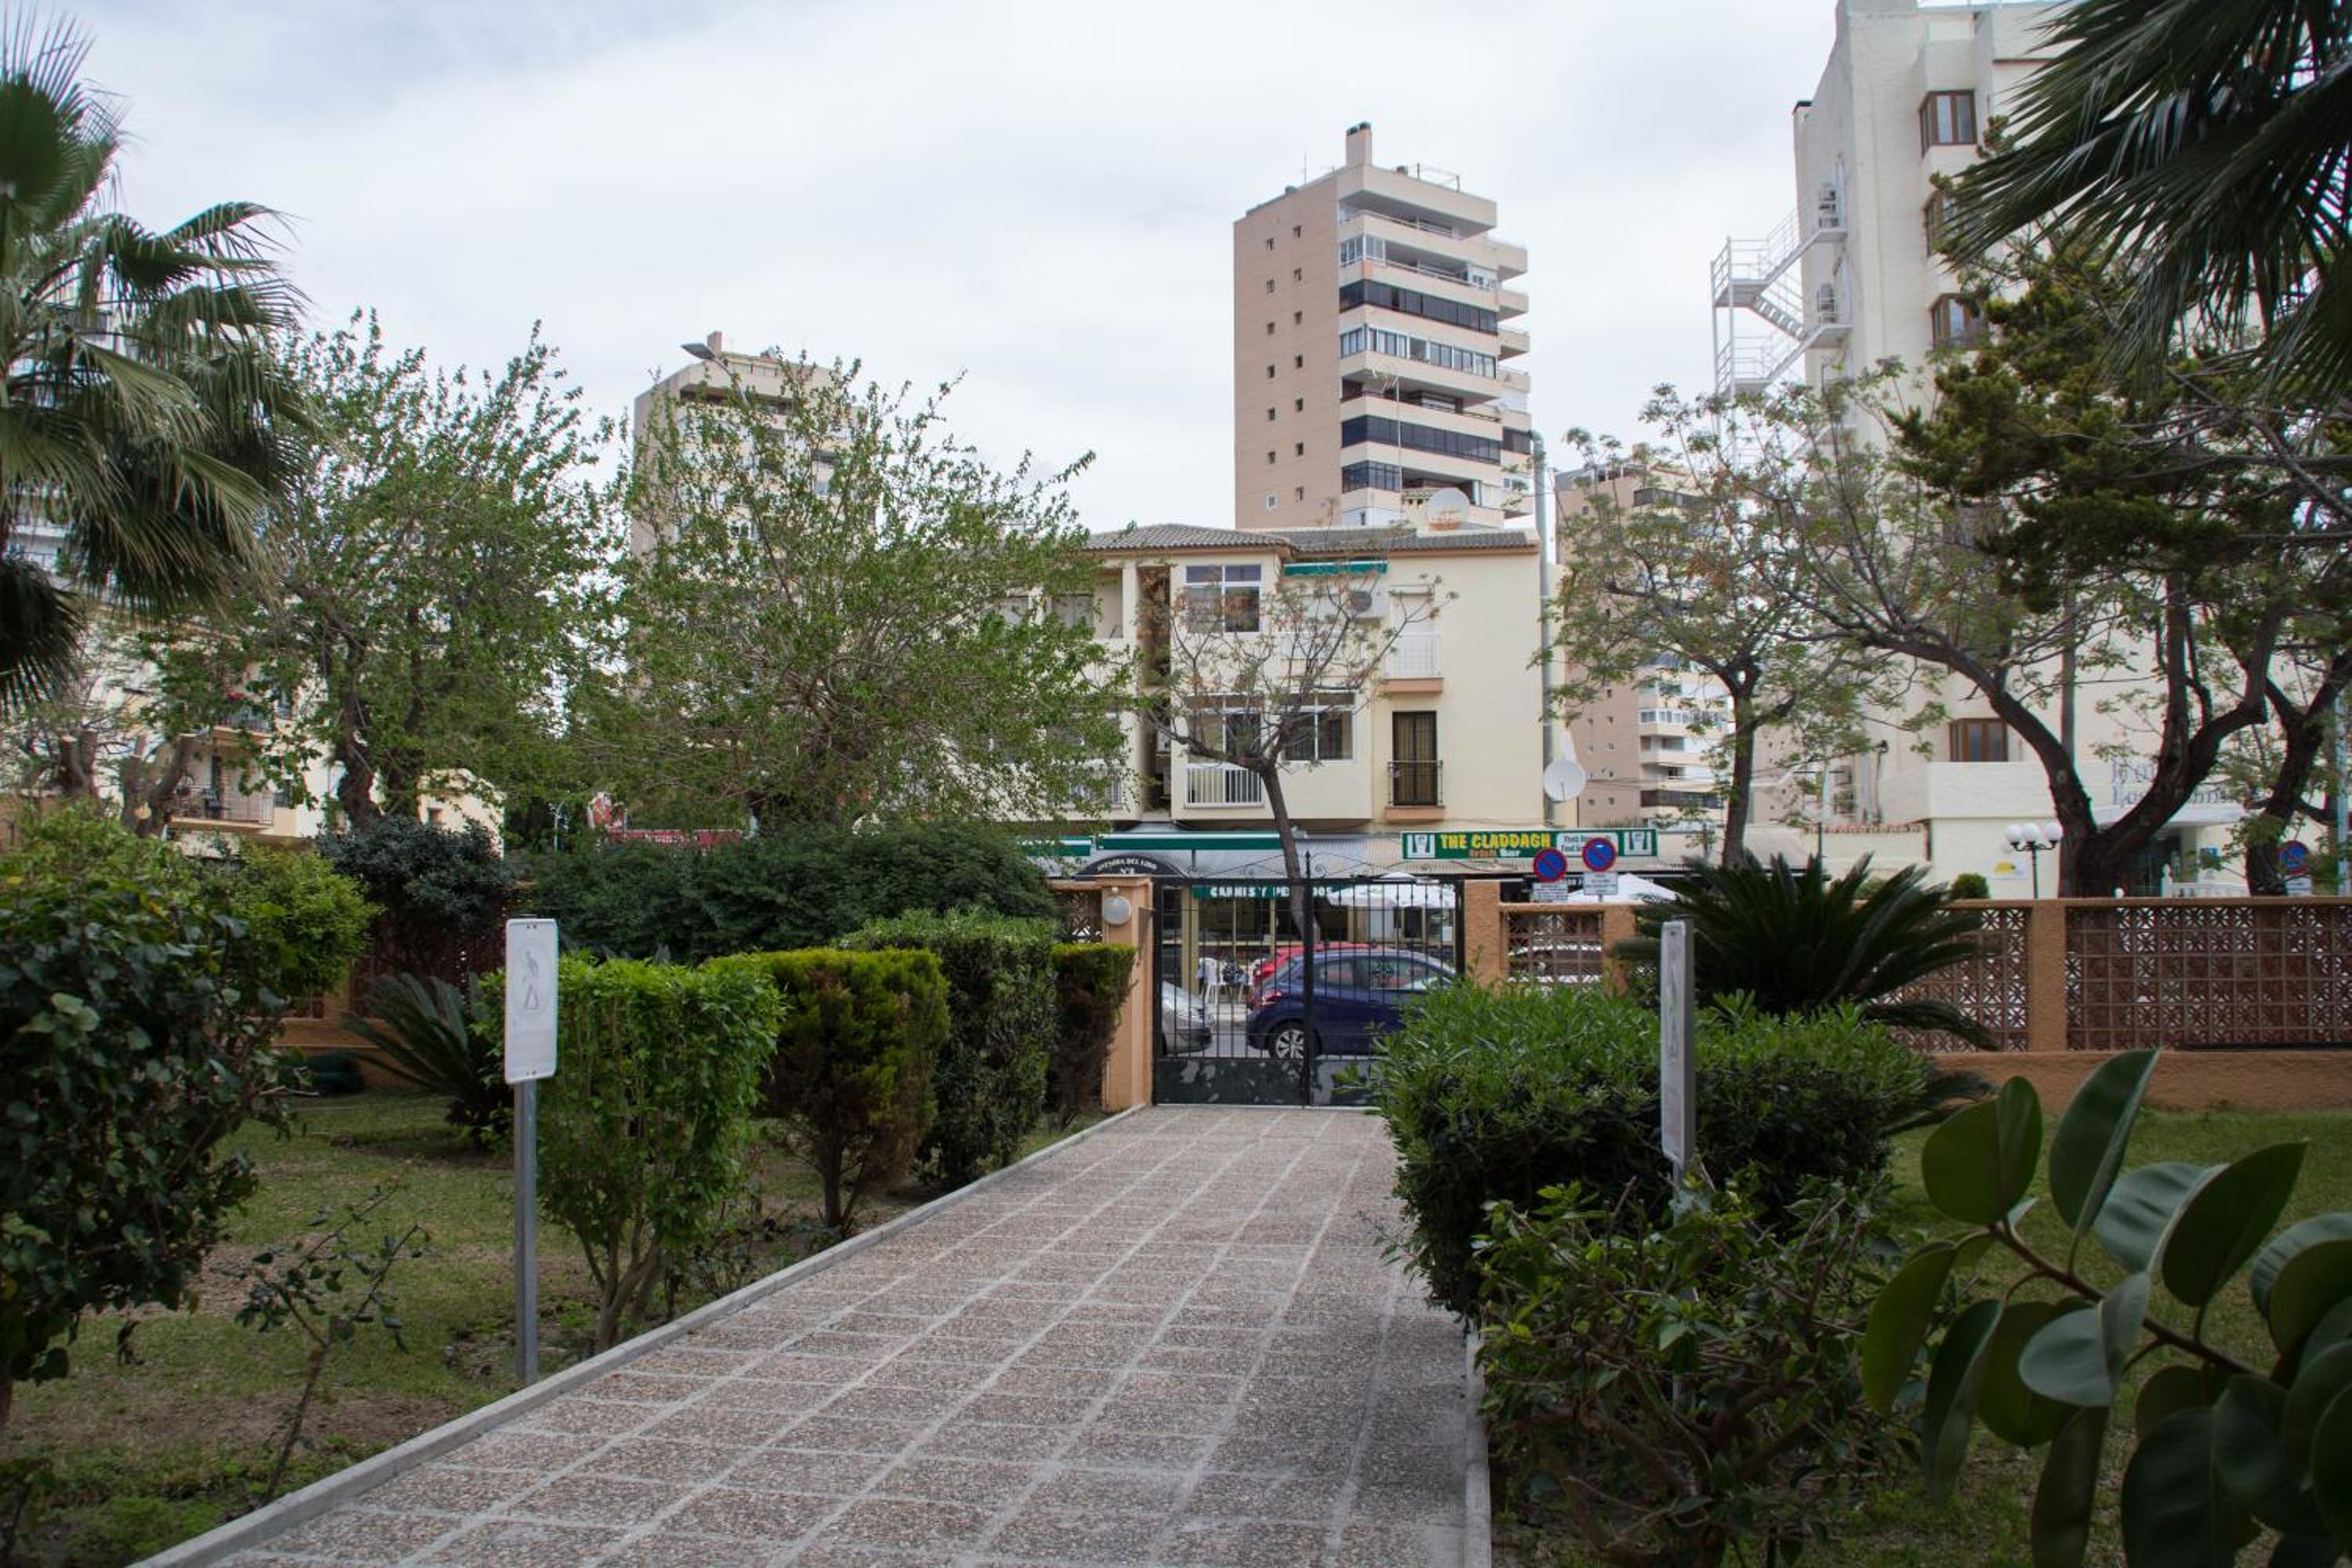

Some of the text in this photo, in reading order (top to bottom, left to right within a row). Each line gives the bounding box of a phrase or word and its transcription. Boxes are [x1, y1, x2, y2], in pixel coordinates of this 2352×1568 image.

[1441, 833, 1468, 849] THE
[1472, 833, 1551, 849] CLADDAGH
[1500, 848, 1521, 858] Bar
